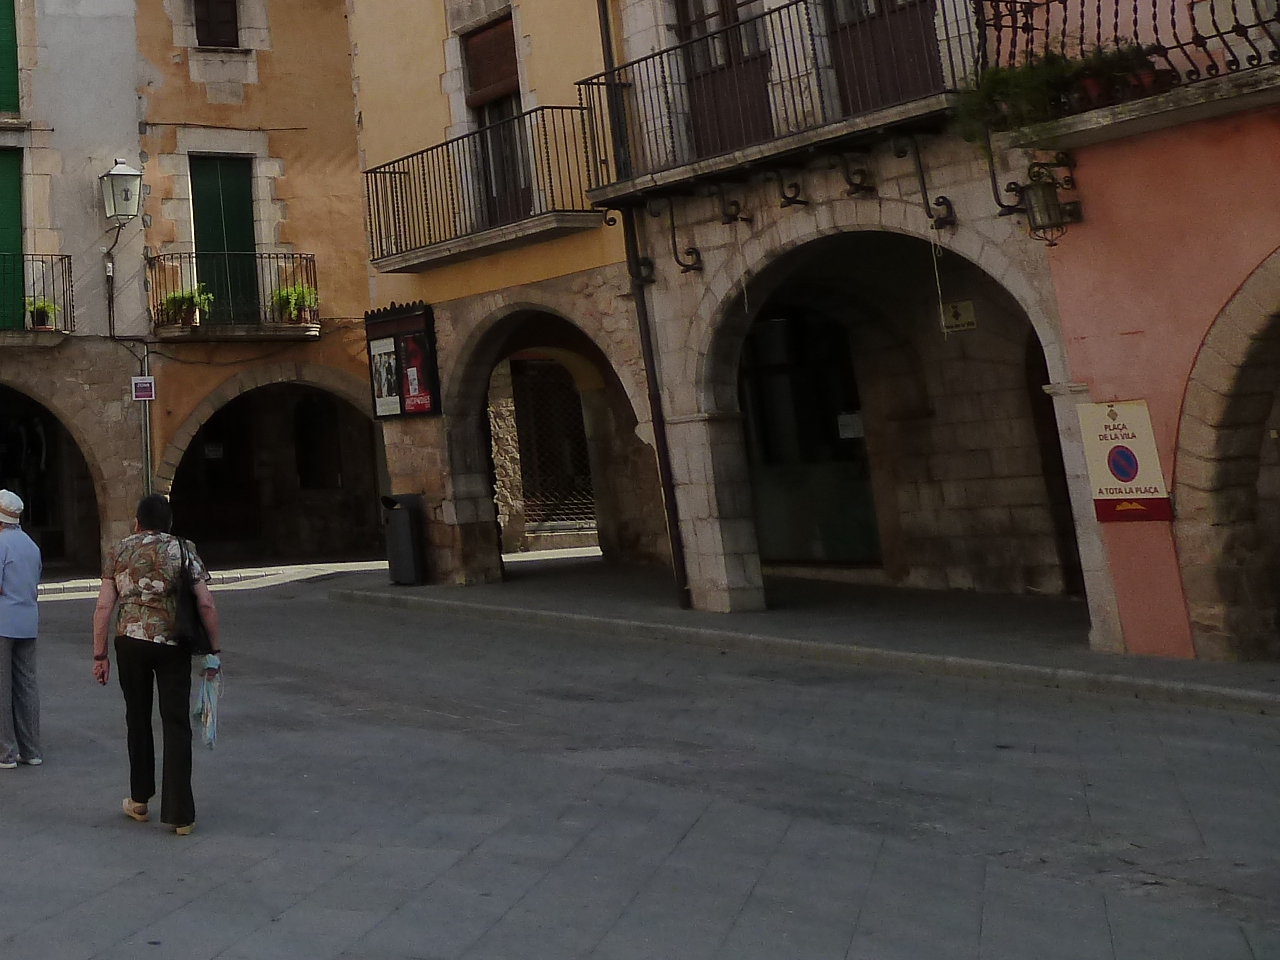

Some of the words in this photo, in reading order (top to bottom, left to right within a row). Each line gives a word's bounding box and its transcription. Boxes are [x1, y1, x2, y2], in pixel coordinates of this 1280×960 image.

[1104, 423, 1128, 432] PLAÇA
[1120, 432, 1137, 440] VILA
[1105, 487, 1123, 495] TOTA
[1135, 486, 1159, 496] PLAÇA
